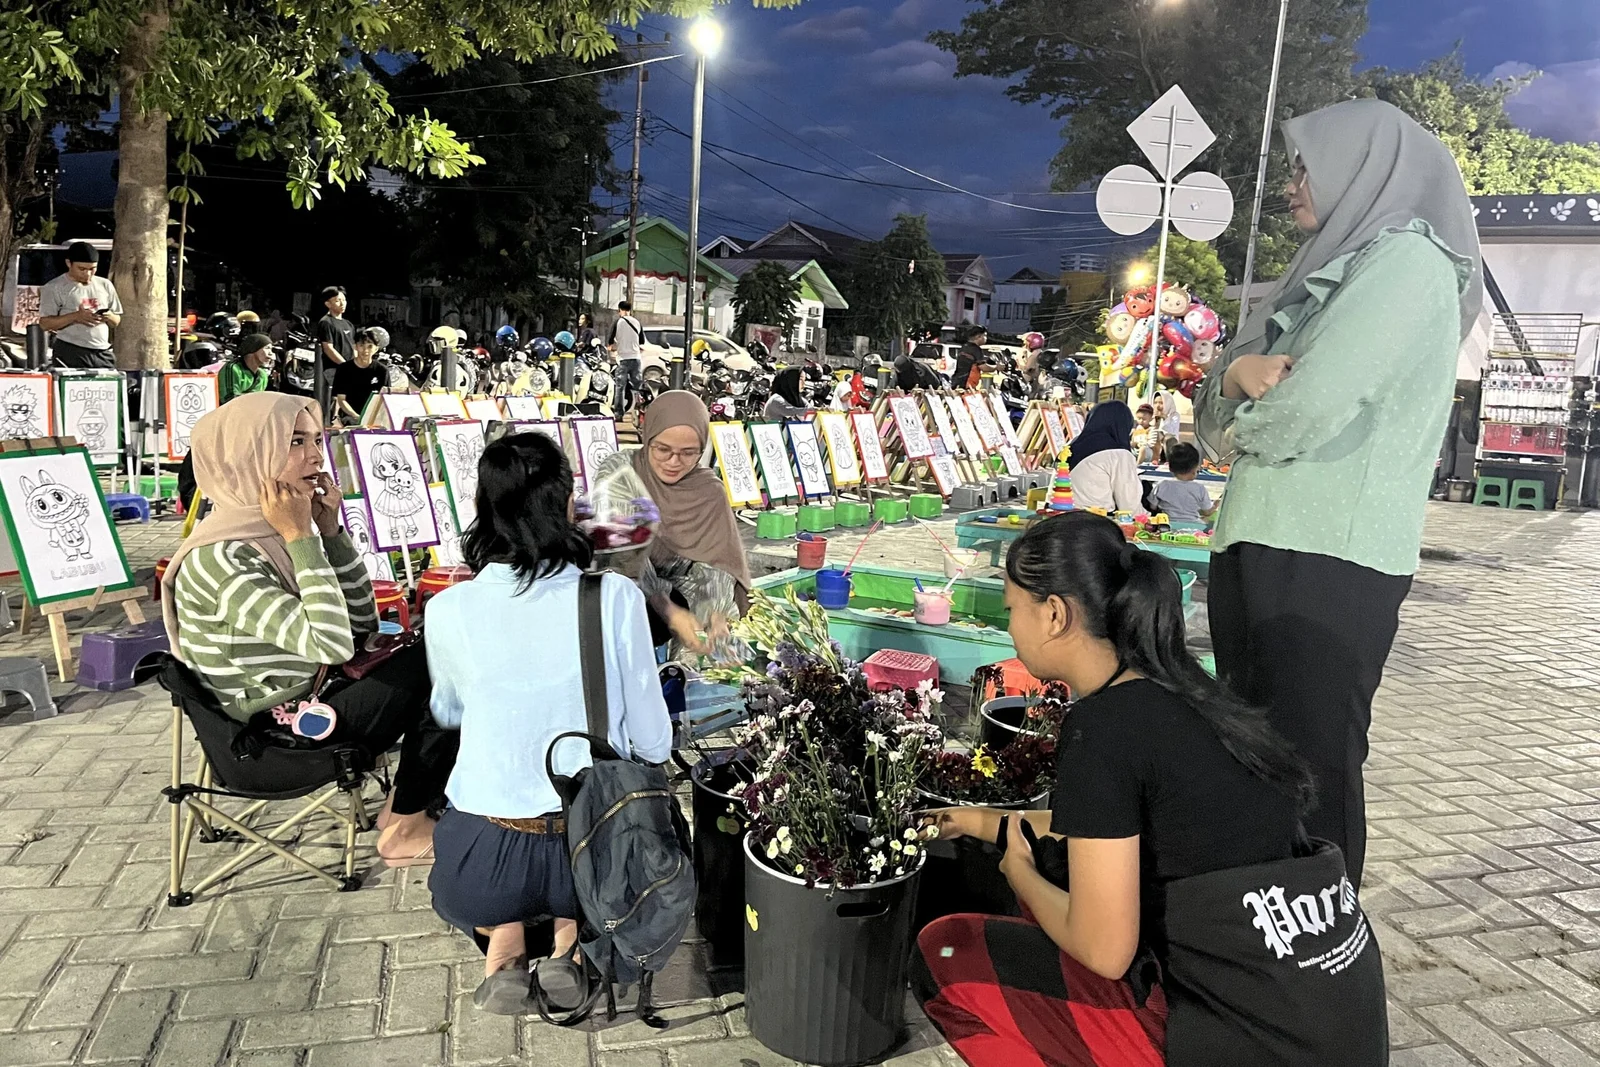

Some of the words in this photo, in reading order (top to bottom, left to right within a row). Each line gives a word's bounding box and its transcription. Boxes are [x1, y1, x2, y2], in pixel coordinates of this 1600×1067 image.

[69, 387, 115, 402] Labubu
[50, 560, 106, 580] LABUBU
[1298, 953, 1325, 968] Instinct
